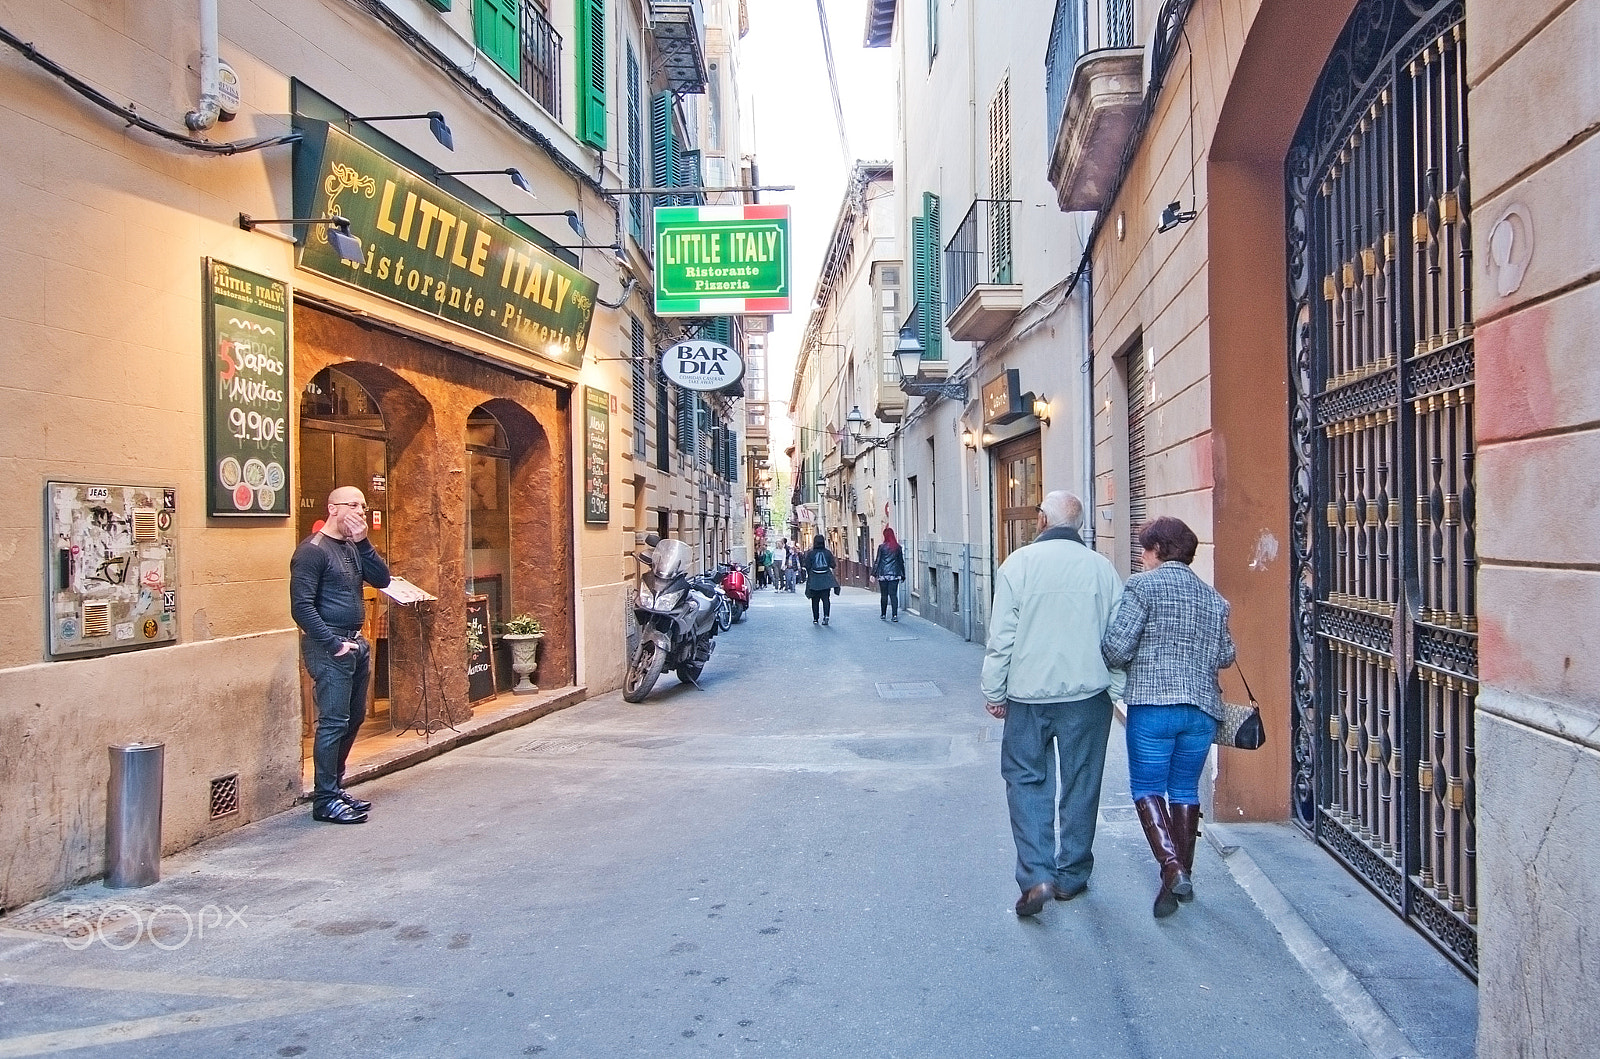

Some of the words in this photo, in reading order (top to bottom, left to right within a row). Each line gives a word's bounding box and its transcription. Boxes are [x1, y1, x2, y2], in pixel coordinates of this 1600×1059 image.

[376, 179, 492, 277] LITTLE
[501, 247, 571, 314] ITALY
[666, 234, 720, 264] LITTLE
[730, 232, 777, 262] ITALY
[686, 266, 759, 277] Ristorante
[220, 274, 252, 294] LITTLE
[256, 286, 281, 303] ITALY
[695, 279, 750, 290] Pizzeria
[214, 286, 253, 303] Ristorante
[501, 303, 571, 352] Pizzeria
[678, 346, 728, 361] BAR
[680, 361, 725, 375] DIA
[229, 377, 283, 403] Mixtas
[230, 408, 285, 442] 9.90€
[89, 488, 107, 497] JEAS
[300, 497, 315, 508] ALY
